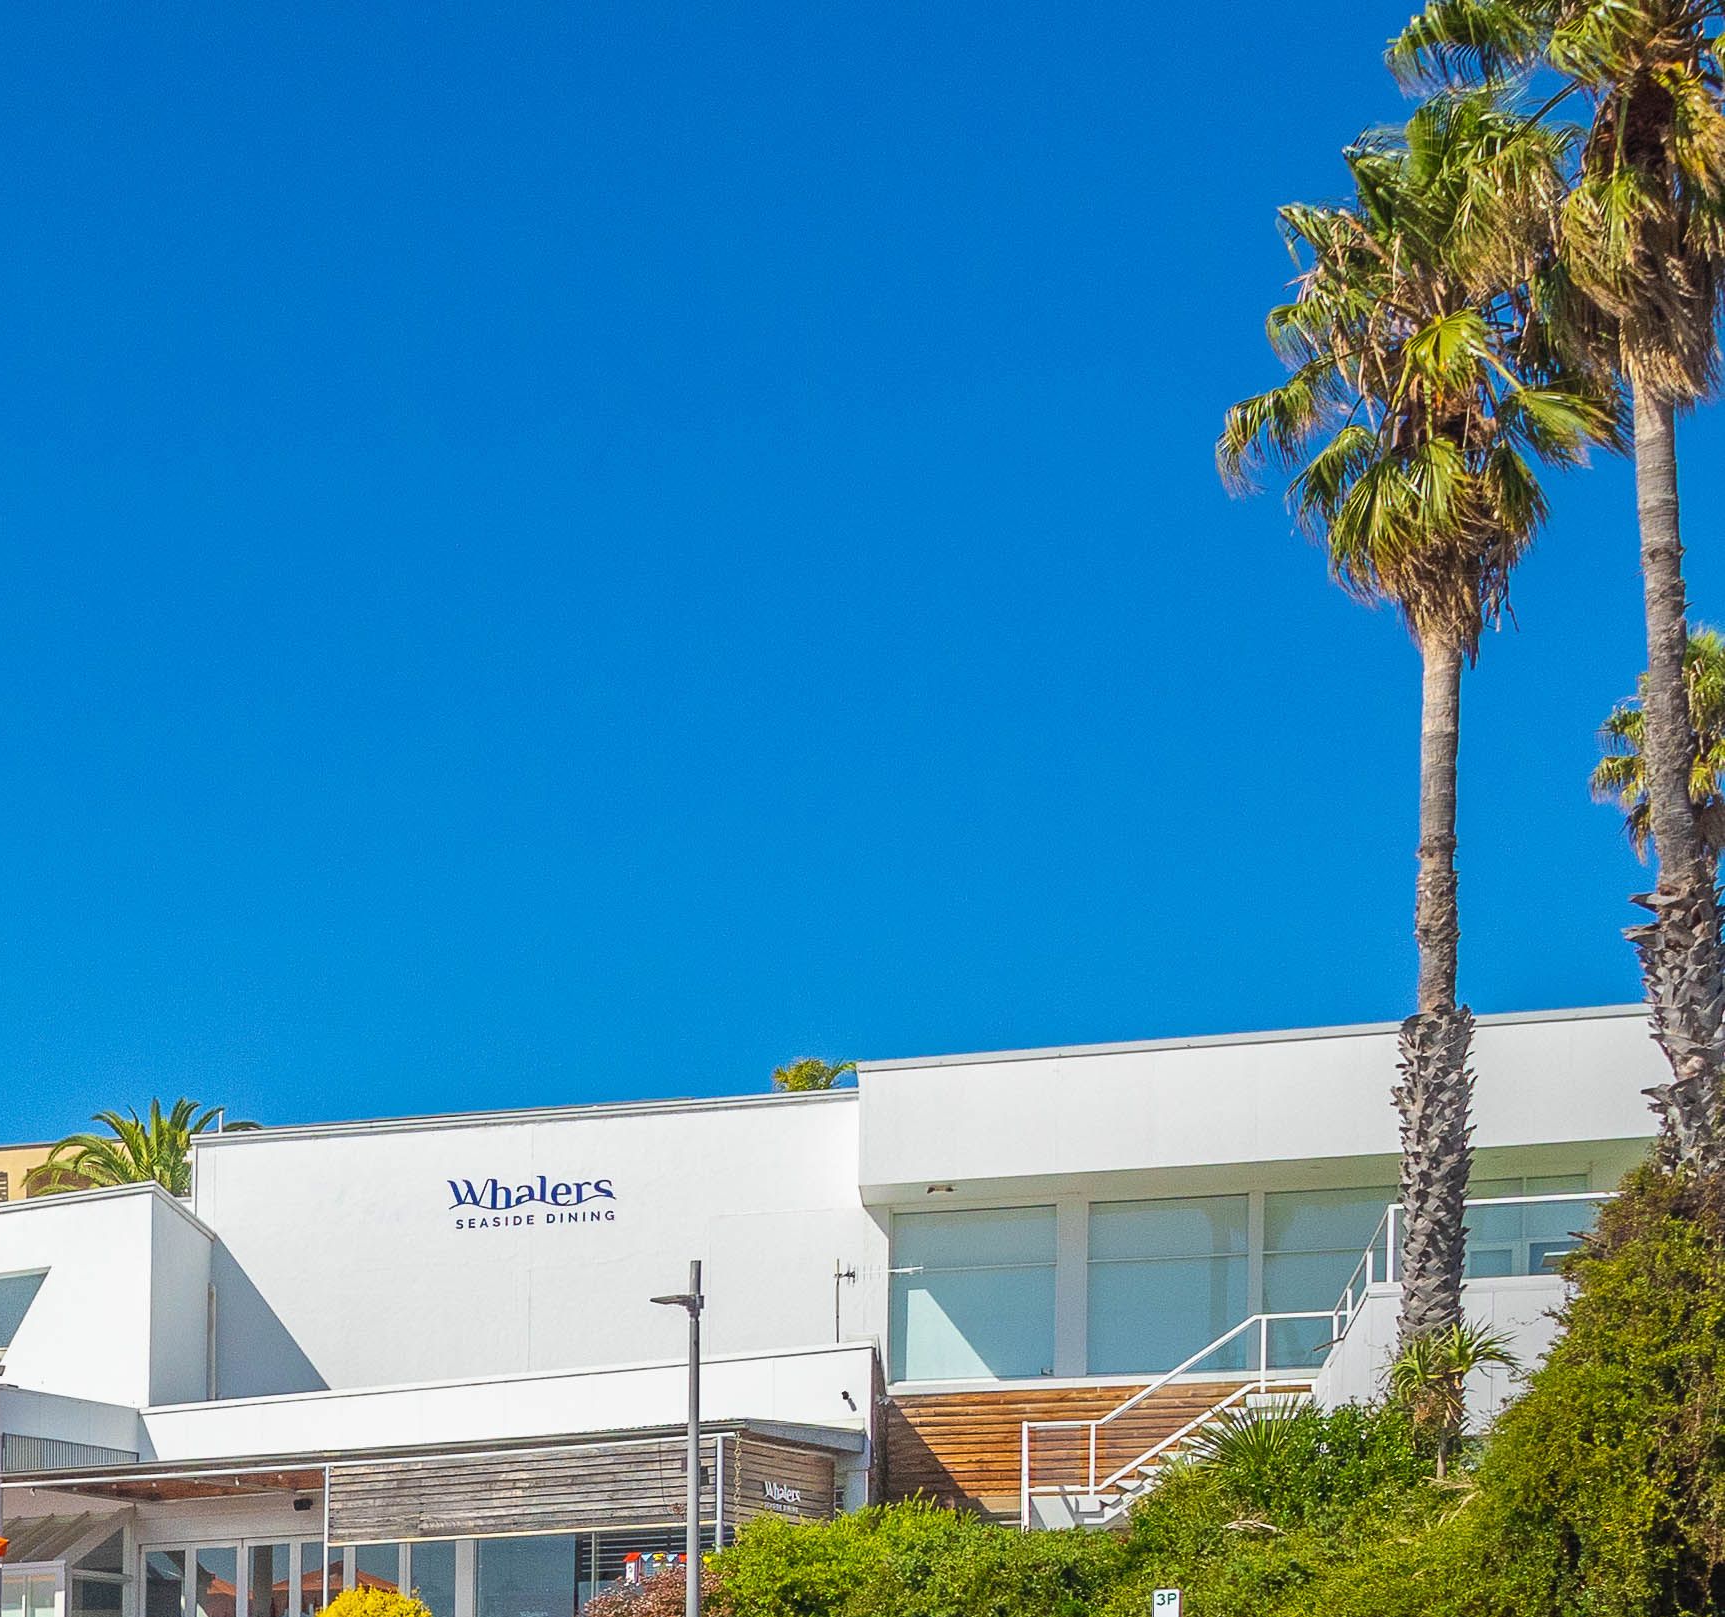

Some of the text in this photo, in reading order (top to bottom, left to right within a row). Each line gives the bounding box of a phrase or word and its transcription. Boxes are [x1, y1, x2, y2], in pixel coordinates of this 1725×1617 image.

[447, 1175, 616, 1210] Whalers
[455, 1210, 616, 1230] SEASIDE DINING
[764, 1480, 801, 1503] Whalers
[1156, 1593, 1177, 1606] 3P
